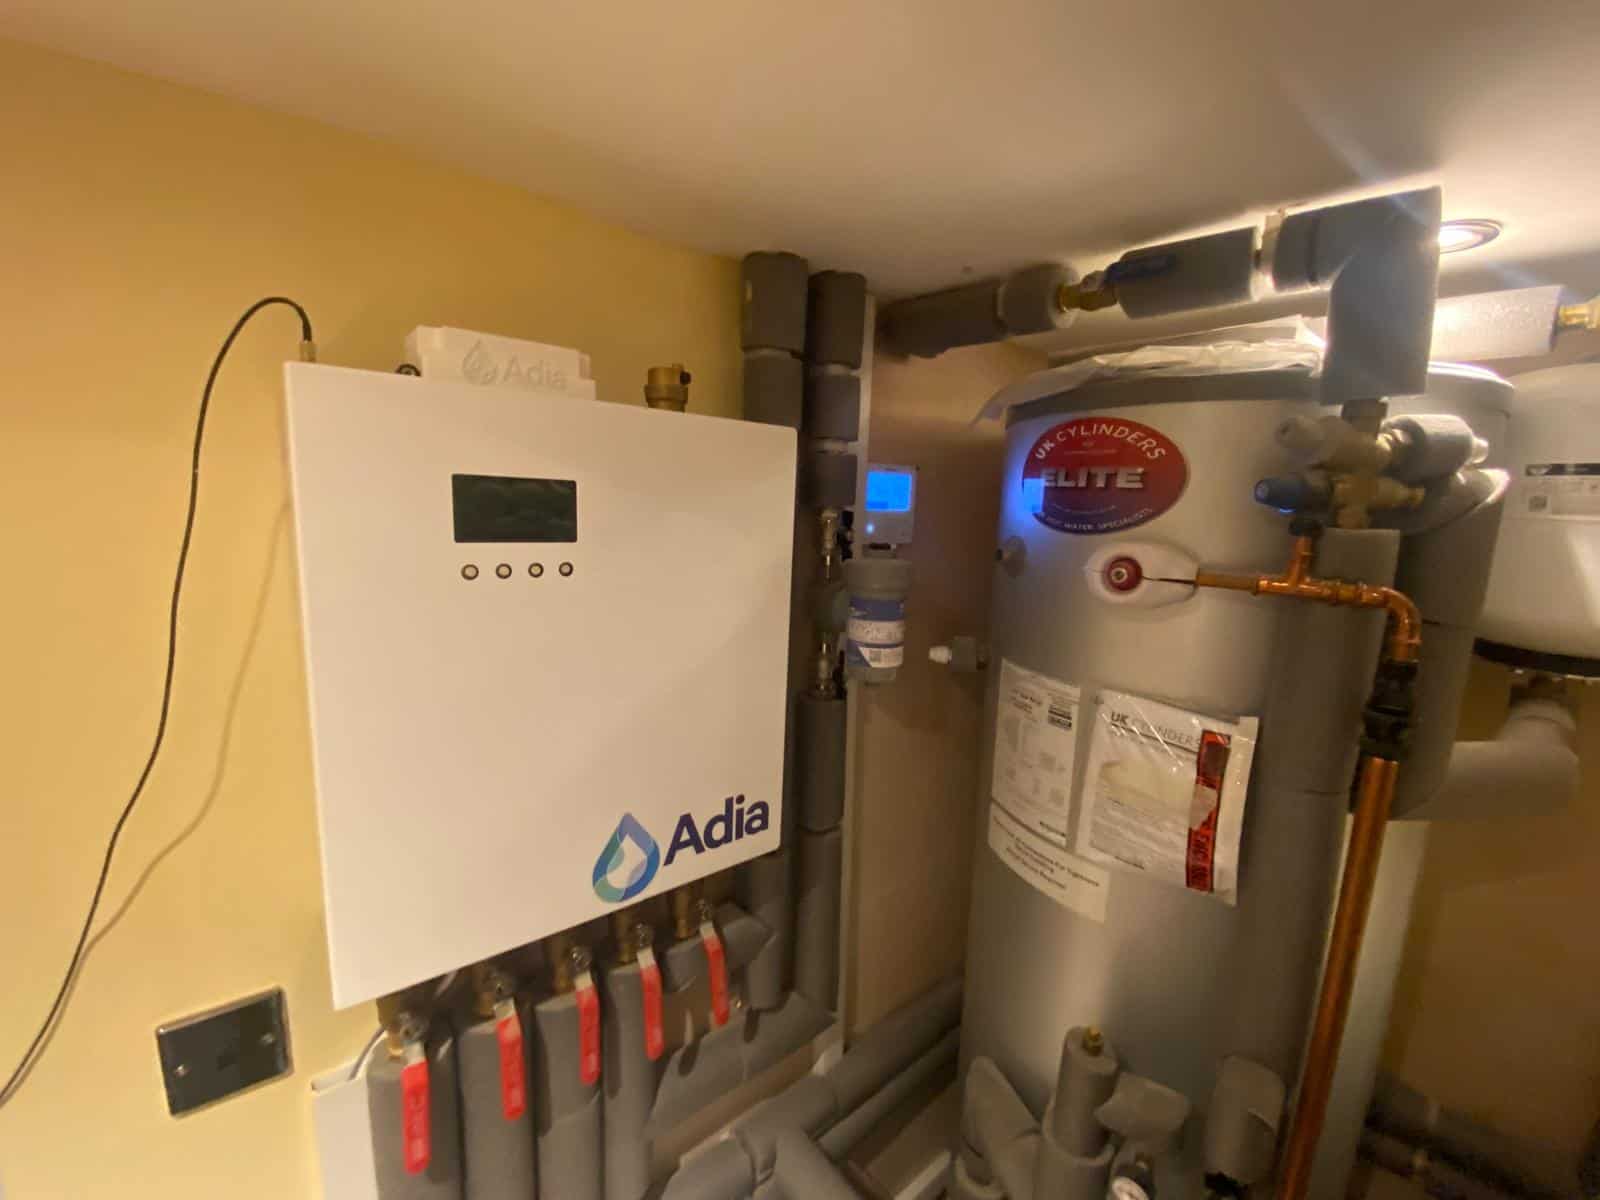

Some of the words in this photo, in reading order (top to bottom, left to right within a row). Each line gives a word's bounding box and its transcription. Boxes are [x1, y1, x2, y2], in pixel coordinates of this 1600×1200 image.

[504, 355, 568, 391] Adia
[1035, 438, 1055, 460] UK
[1056, 423, 1166, 460] CYLINDERS
[1041, 467, 1144, 489] ELITE
[1111, 711, 1129, 726] UK
[663, 794, 770, 867] Adia
